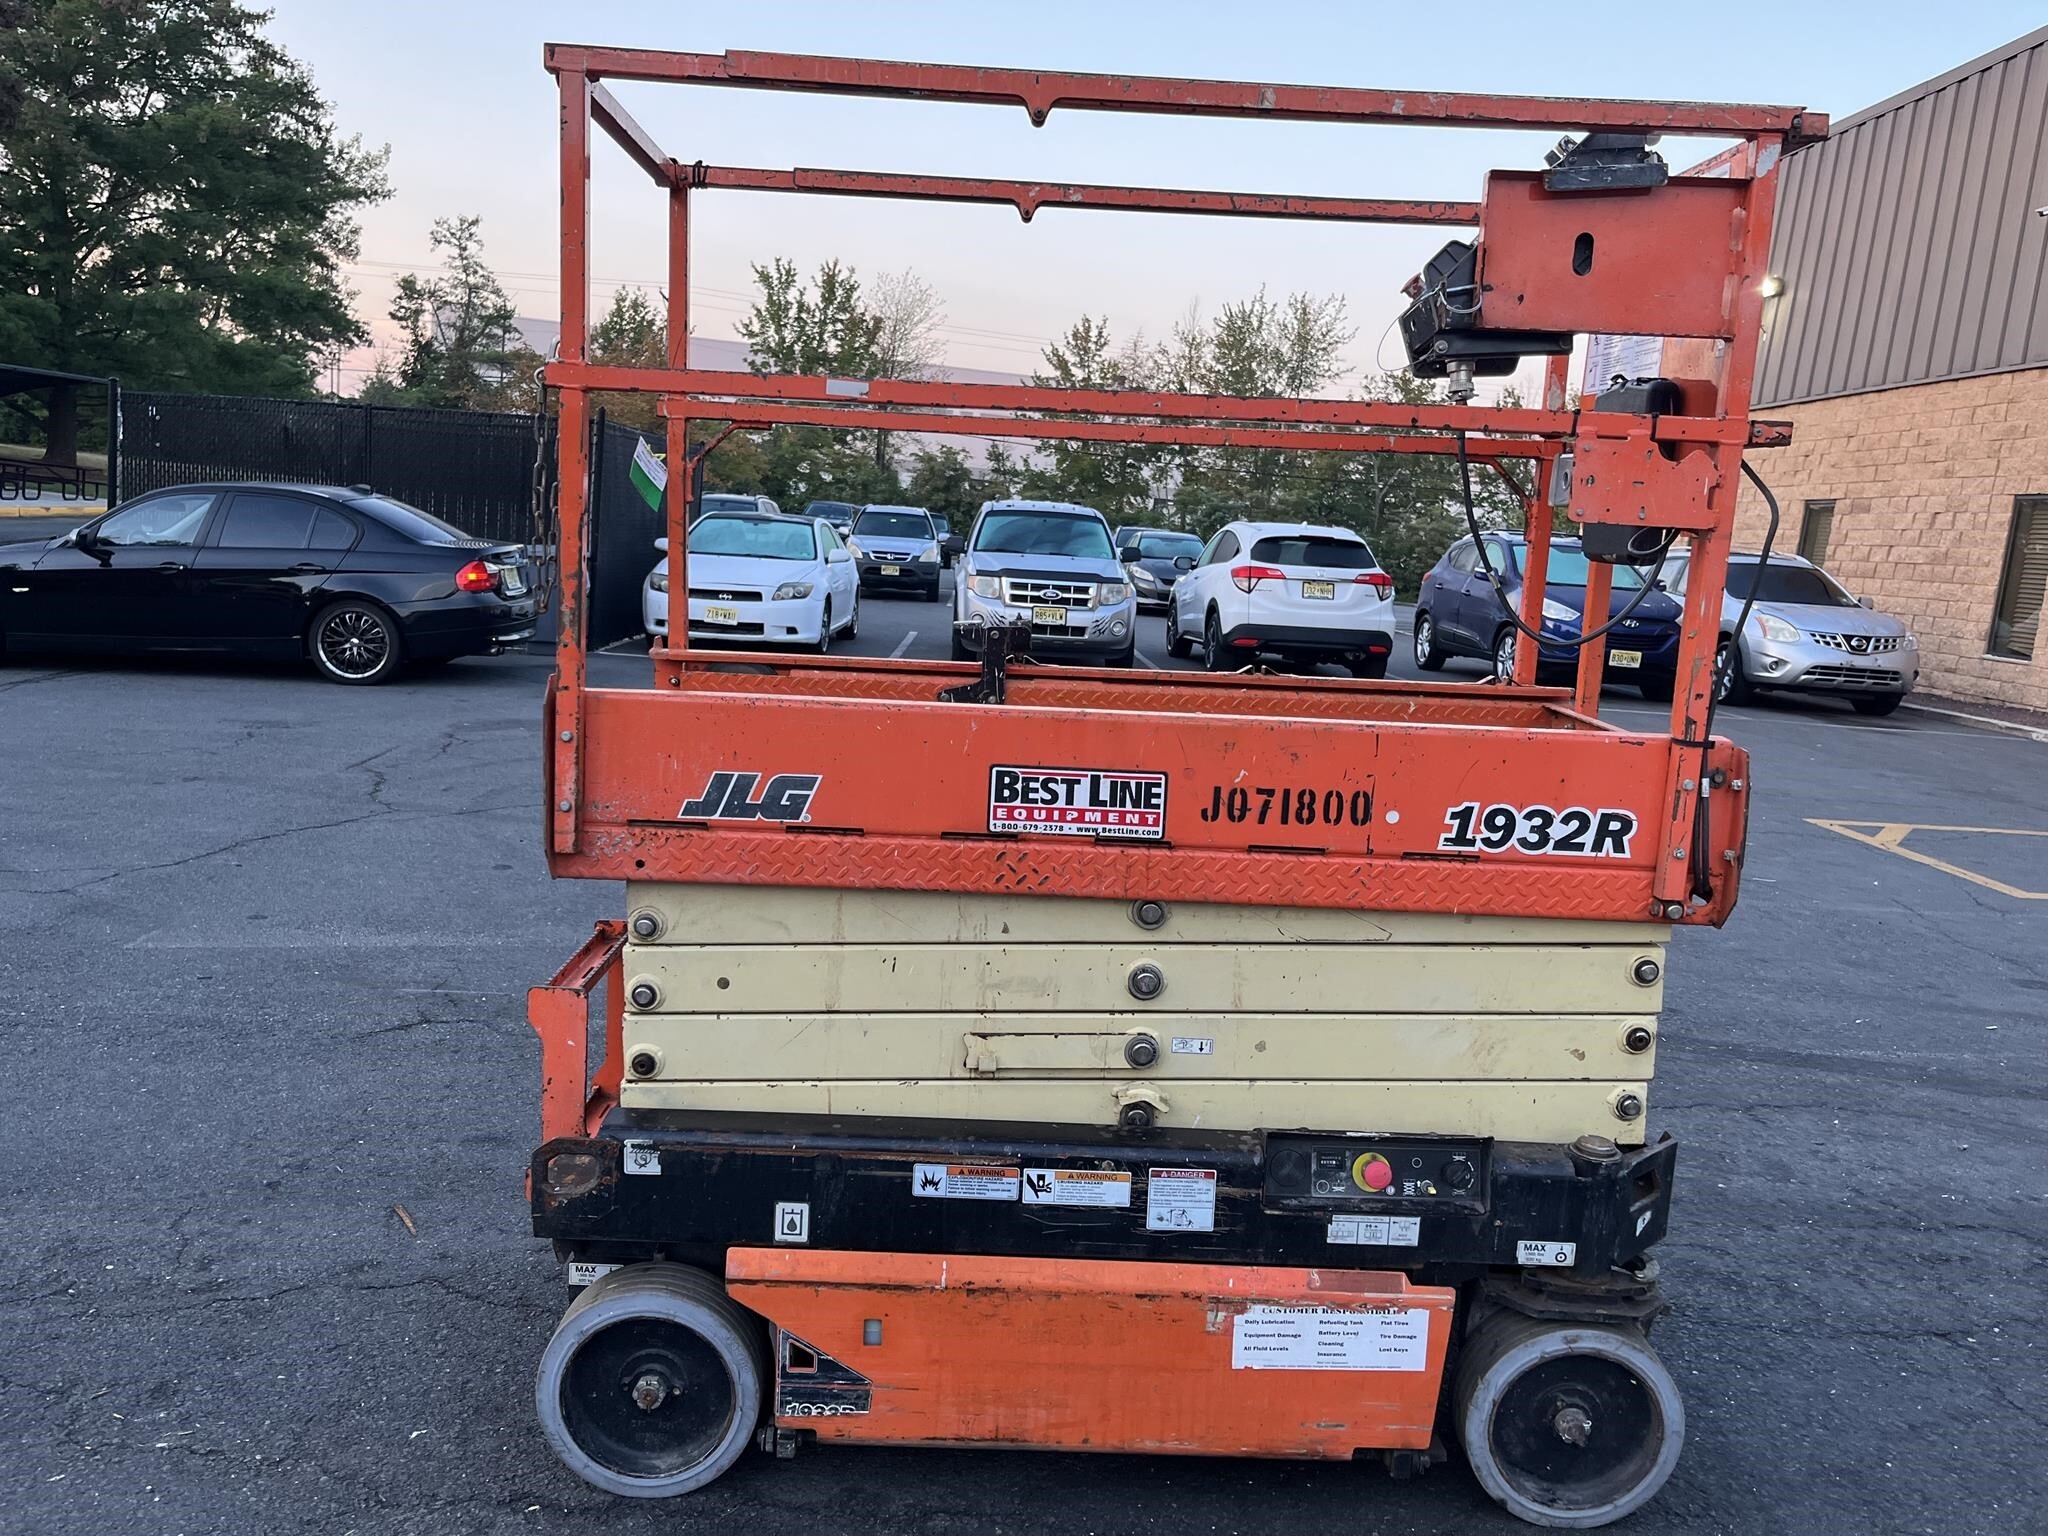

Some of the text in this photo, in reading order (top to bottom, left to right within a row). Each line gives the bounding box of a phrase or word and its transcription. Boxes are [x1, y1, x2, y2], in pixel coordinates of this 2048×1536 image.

[677, 771, 823, 822] JLG
[994, 769, 1162, 810] BEST LINE
[996, 808, 1157, 824] EQUIPMENT
[1200, 786, 1371, 826] J071800
[1437, 802, 1638, 858] 1932R
[968, 1168, 1006, 1177] WARNING
[1077, 1173, 1118, 1181] WARNING
[1523, 1244, 1546, 1252] MAX
